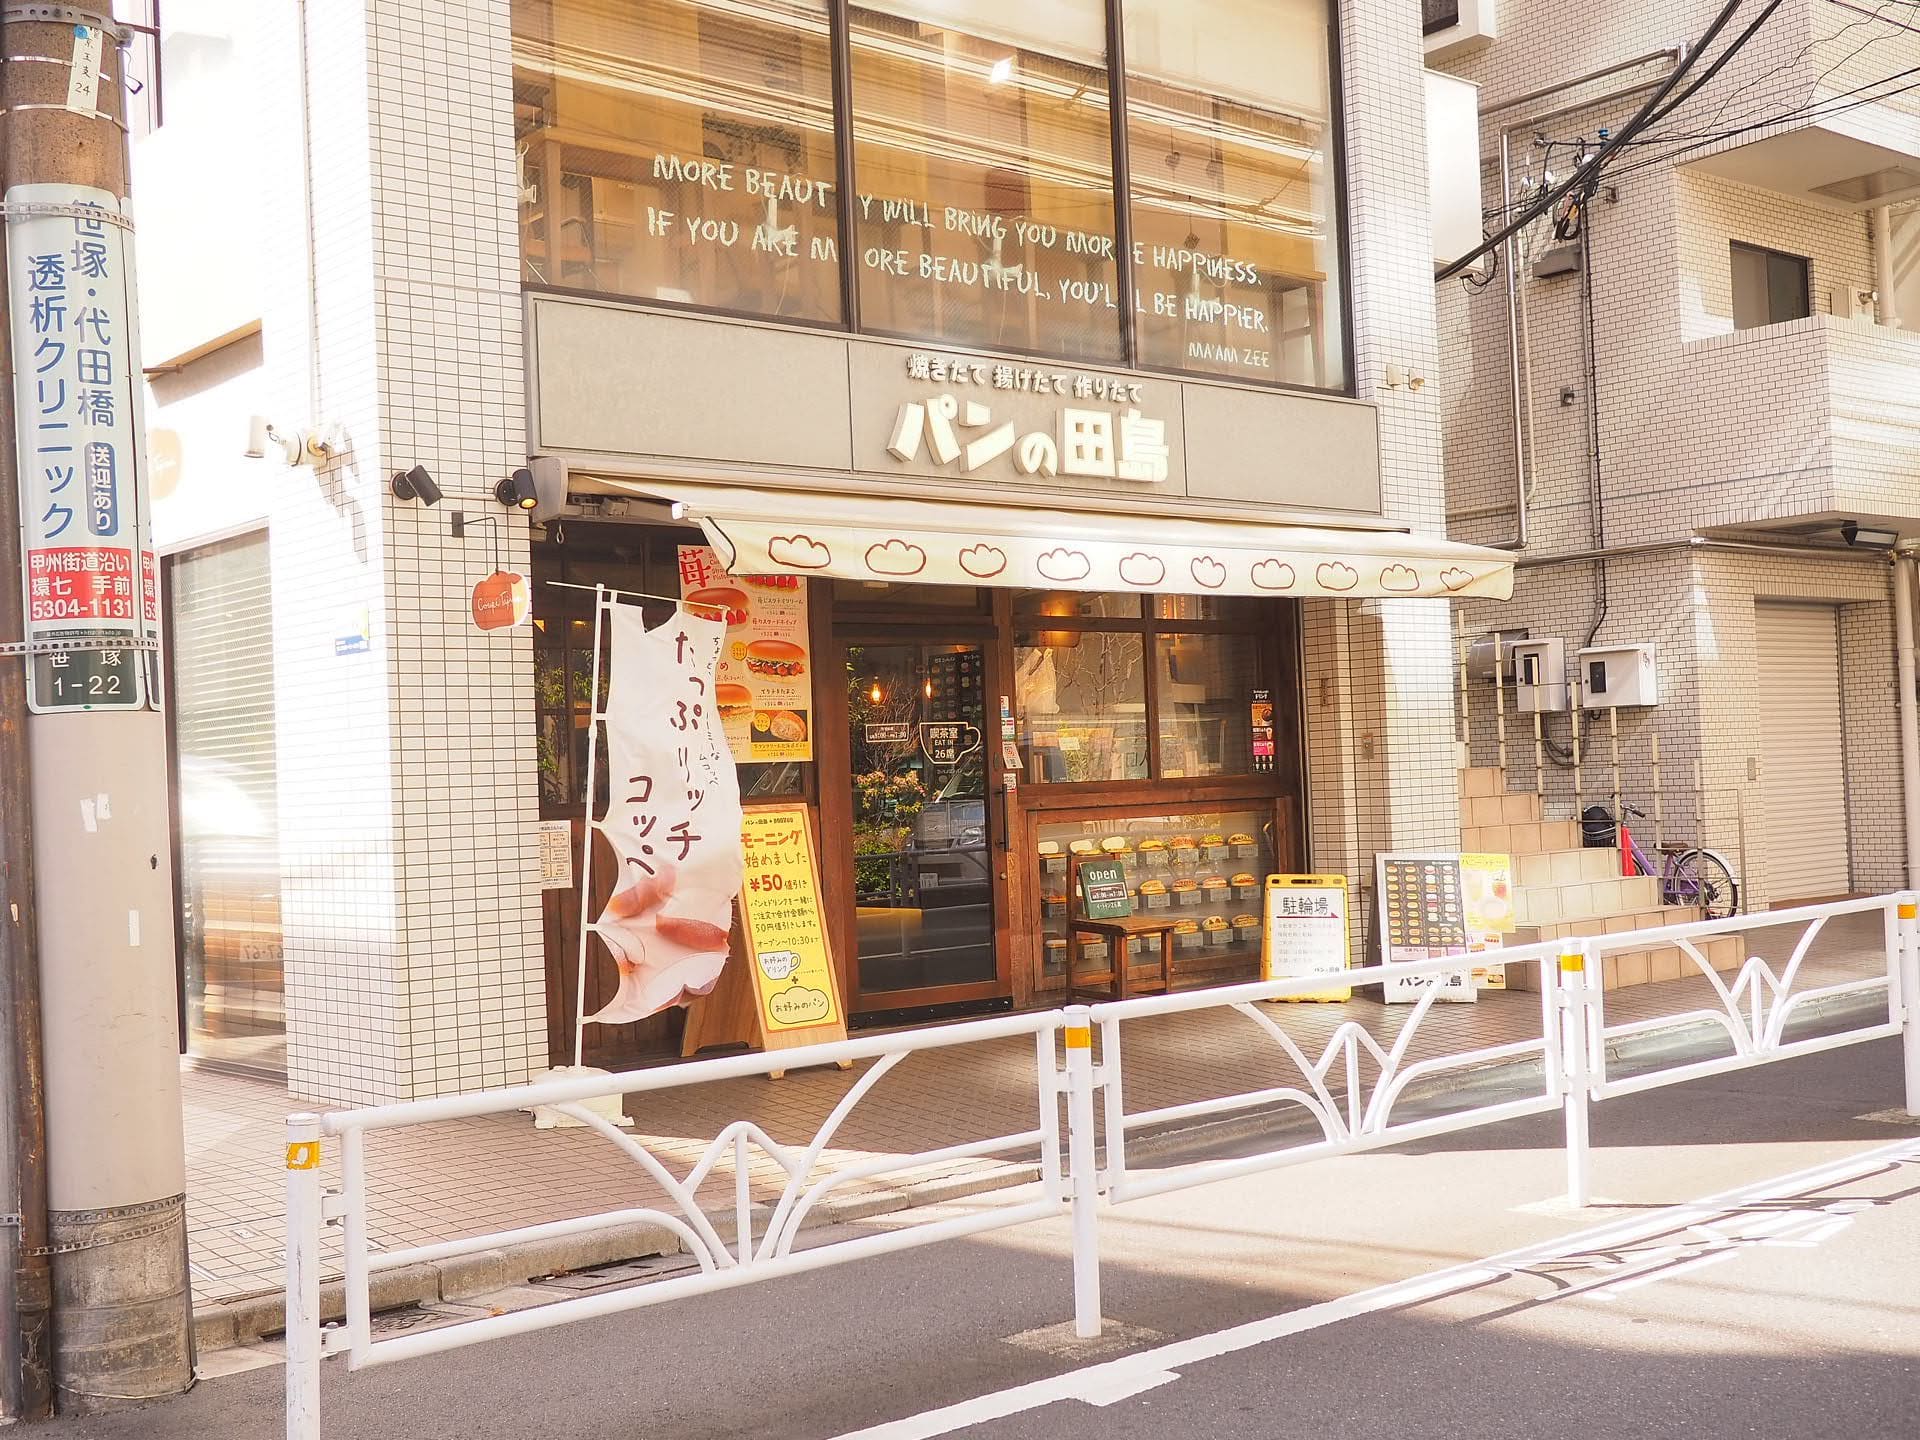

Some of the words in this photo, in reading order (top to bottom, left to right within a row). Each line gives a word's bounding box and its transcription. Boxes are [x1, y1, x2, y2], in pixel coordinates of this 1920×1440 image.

[75, 82, 91, 95] 24
[653, 153, 735, 191] MORE
[883, 198, 937, 229] WILL
[944, 206, 1007, 241] BRING
[1016, 222, 1057, 249] YOU
[647, 206, 674, 237] IF
[687, 216, 740, 247] YOU
[751, 224, 799, 257] ARE
[1154, 293, 1177, 317] BE
[1244, 349, 1270, 369] ZEE
[907, 354, 986, 385] 焼きたて
[992, 364, 1067, 395] 揚げたて
[1072, 376, 1143, 404] 作りたて
[27, 253, 74, 539] 透析クリニック
[886, 393, 1169, 483] パンの田島
[89, 446, 112, 531] 送迎あり
[31, 551, 130, 574] 甲州街道沿い
[679, 549, 711, 588] 苺
[32, 576, 72, 597] 環七
[92, 575, 130, 596] 手前
[33, 598, 131, 619] 5304-1131
[101, 649, 121, 667] 塚
[54, 675, 120, 697] 1-22
[626, 775, 657, 875] コッペ
[740, 829, 803, 849] モーニング
[744, 852, 808, 868] 始めました
[1089, 869, 1118, 881] open
[1282, 897, 1328, 915] 駐輪場
[1399, 975, 1463, 987] パンの島
[775, 998, 825, 1012] お好みのパン
